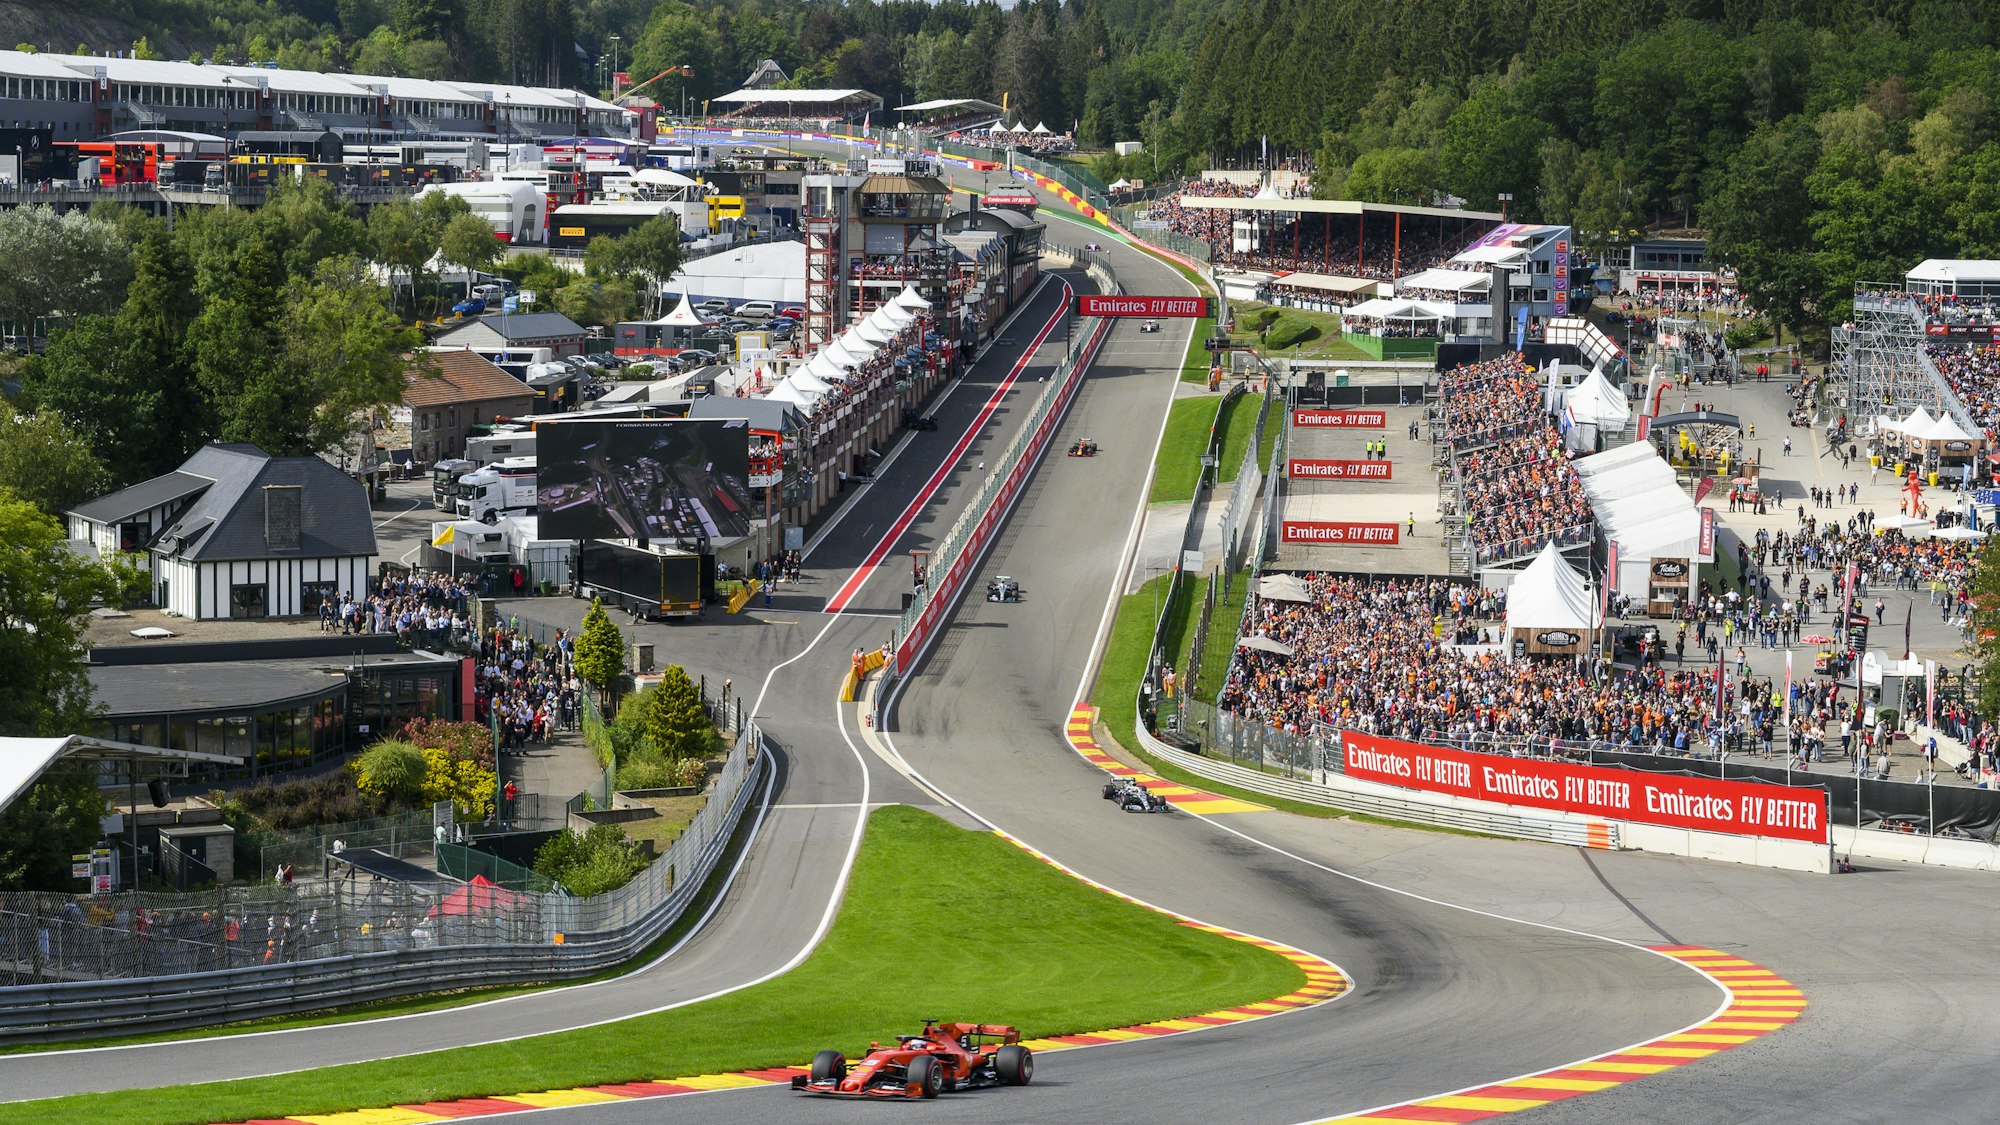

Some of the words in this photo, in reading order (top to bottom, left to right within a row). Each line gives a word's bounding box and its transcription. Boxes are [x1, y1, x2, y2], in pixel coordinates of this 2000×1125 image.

[1090, 299, 1147, 313] Emirates
[1151, 300, 1166, 313] FLY
[1166, 300, 1198, 314] BETTER
[1297, 413, 1342, 425] Emirates
[1345, 414, 1358, 425] FLY
[1357, 414, 1382, 426] BETTER
[1293, 463, 1343, 476] Emirates
[1346, 464, 1360, 476] FLY
[1360, 464, 1388, 476] BETTER
[1287, 526, 1344, 539] Emirates
[1347, 527, 1363, 540] FLY
[1363, 528, 1395, 541] BETTER
[1660, 564, 1680, 573] Tickets
[1547, 632, 1569, 641] DRINKS
[1347, 742, 1412, 778] Emirates
[1415, 755, 1434, 782] FLY
[1433, 758, 1472, 789] BETTER
[1482, 766, 1559, 800] Emirates
[1565, 775, 1586, 803] FLY
[1587, 778, 1631, 809] BETTER
[1645, 785, 1734, 821] Emirates
[1740, 795, 1764, 825] FLY
[1766, 798, 1817, 831] BETTER
